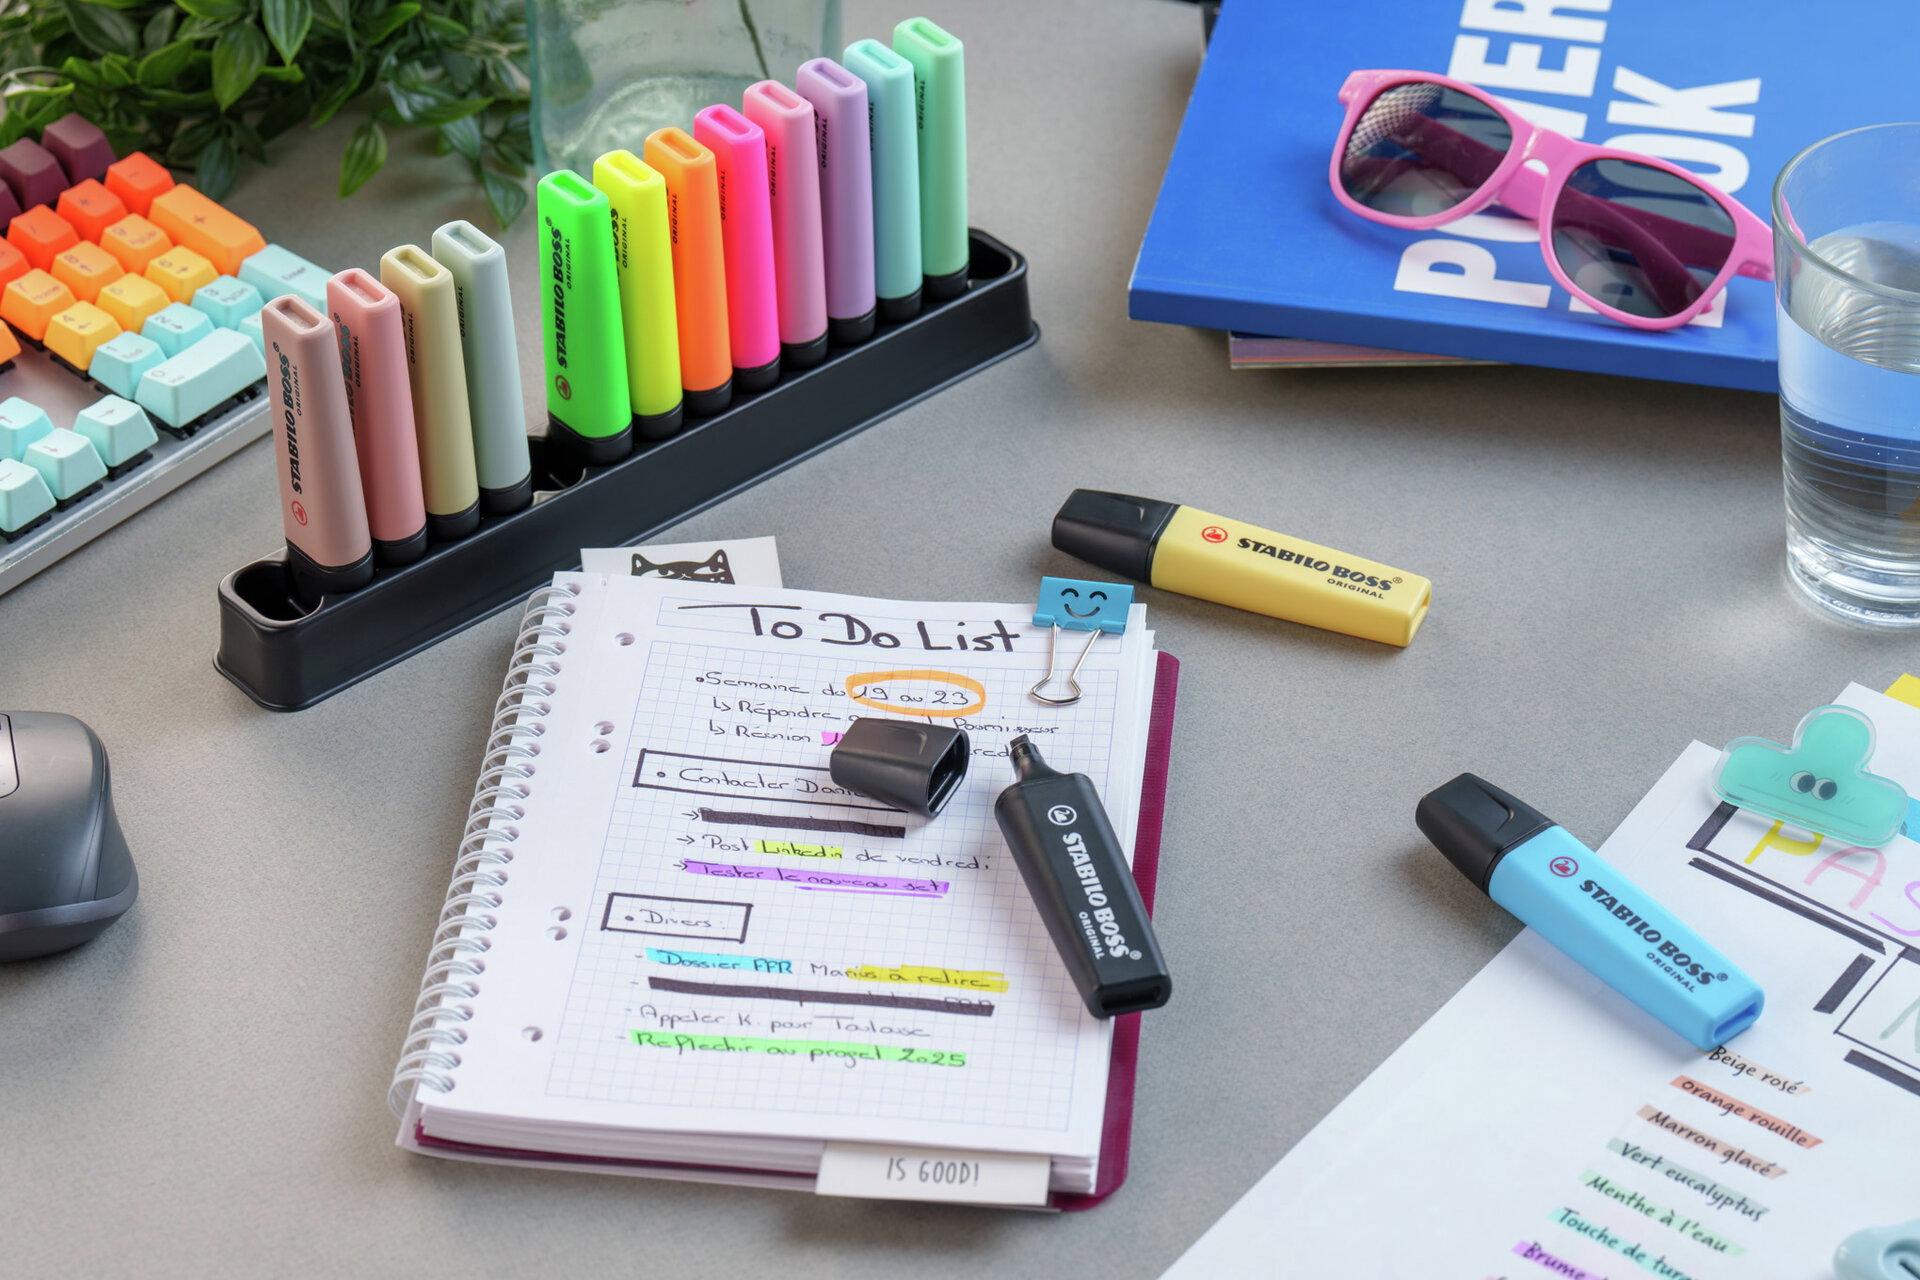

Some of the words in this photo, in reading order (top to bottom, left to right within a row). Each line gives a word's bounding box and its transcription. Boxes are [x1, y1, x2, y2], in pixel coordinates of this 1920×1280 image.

[565, 238, 573, 290] ORIGINAL
[553, 285, 568, 369] STABILO
[352, 335, 361, 388] ORIGINAL
[294, 364, 303, 417] ORIGINAL
[281, 410, 302, 495] STABILO
[1237, 537, 1330, 573] STABILO
[1326, 577, 1385, 600] ORIGINAL
[817, 612, 901, 649] Do
[916, 619, 1021, 653] List
[705, 671, 810, 695] Semaine
[853, 686, 890, 702] 19
[930, 690, 969, 706] 23
[738, 699, 841, 723] Répondre
[735, 724, 811, 743] Réunion
[679, 767, 790, 790] Contacter
[702, 834, 750, 851] Post
[856, 849, 888, 863] de
[896, 854, 991, 870] vendredi
[1062, 831, 1108, 908] STABILO
[685, 860, 765, 879] Tester
[776, 867, 802, 881] le
[807, 876, 888, 889] nouveau
[903, 879, 940, 892] set
[640, 907, 712, 928] Divers
[1579, 878, 1662, 944] STABILO
[1078, 911, 1105, 960] ORIGINAL
[655, 949, 742, 970] Dossier
[810, 962, 877, 980] Marius
[917, 970, 991, 989] relire
[1645, 951, 1696, 993] ORIGINAL
[640, 1004, 726, 1029] Appeler
[770, 1020, 813, 1033] pour
[814, 1015, 931, 1038] Toulouse
[766, 1046, 797, 1056] au
[898, 1047, 967, 1068] 2025
[1708, 1045, 1757, 1077] Beige
[1760, 1072, 1804, 1095] rosé
[1647, 1111, 1718, 1151] Marron
[1719, 1149, 1776, 1177] glacé
[1750, 1112, 1809, 1147] rouille
[886, 1157, 907, 1182] IS
[1621, 1142, 1663, 1169] Vert
[1664, 1168, 1763, 1222] eucalyptus
[1558, 1206, 1620, 1250] Touche
[1622, 1243, 1647, 1265] de
[1585, 1177, 1656, 1217] Menthe
[1659, 1210, 1676, 1227] à
[1678, 1219, 1729, 1254] l'eau
[1522, 1240, 1586, 1280] Brume
